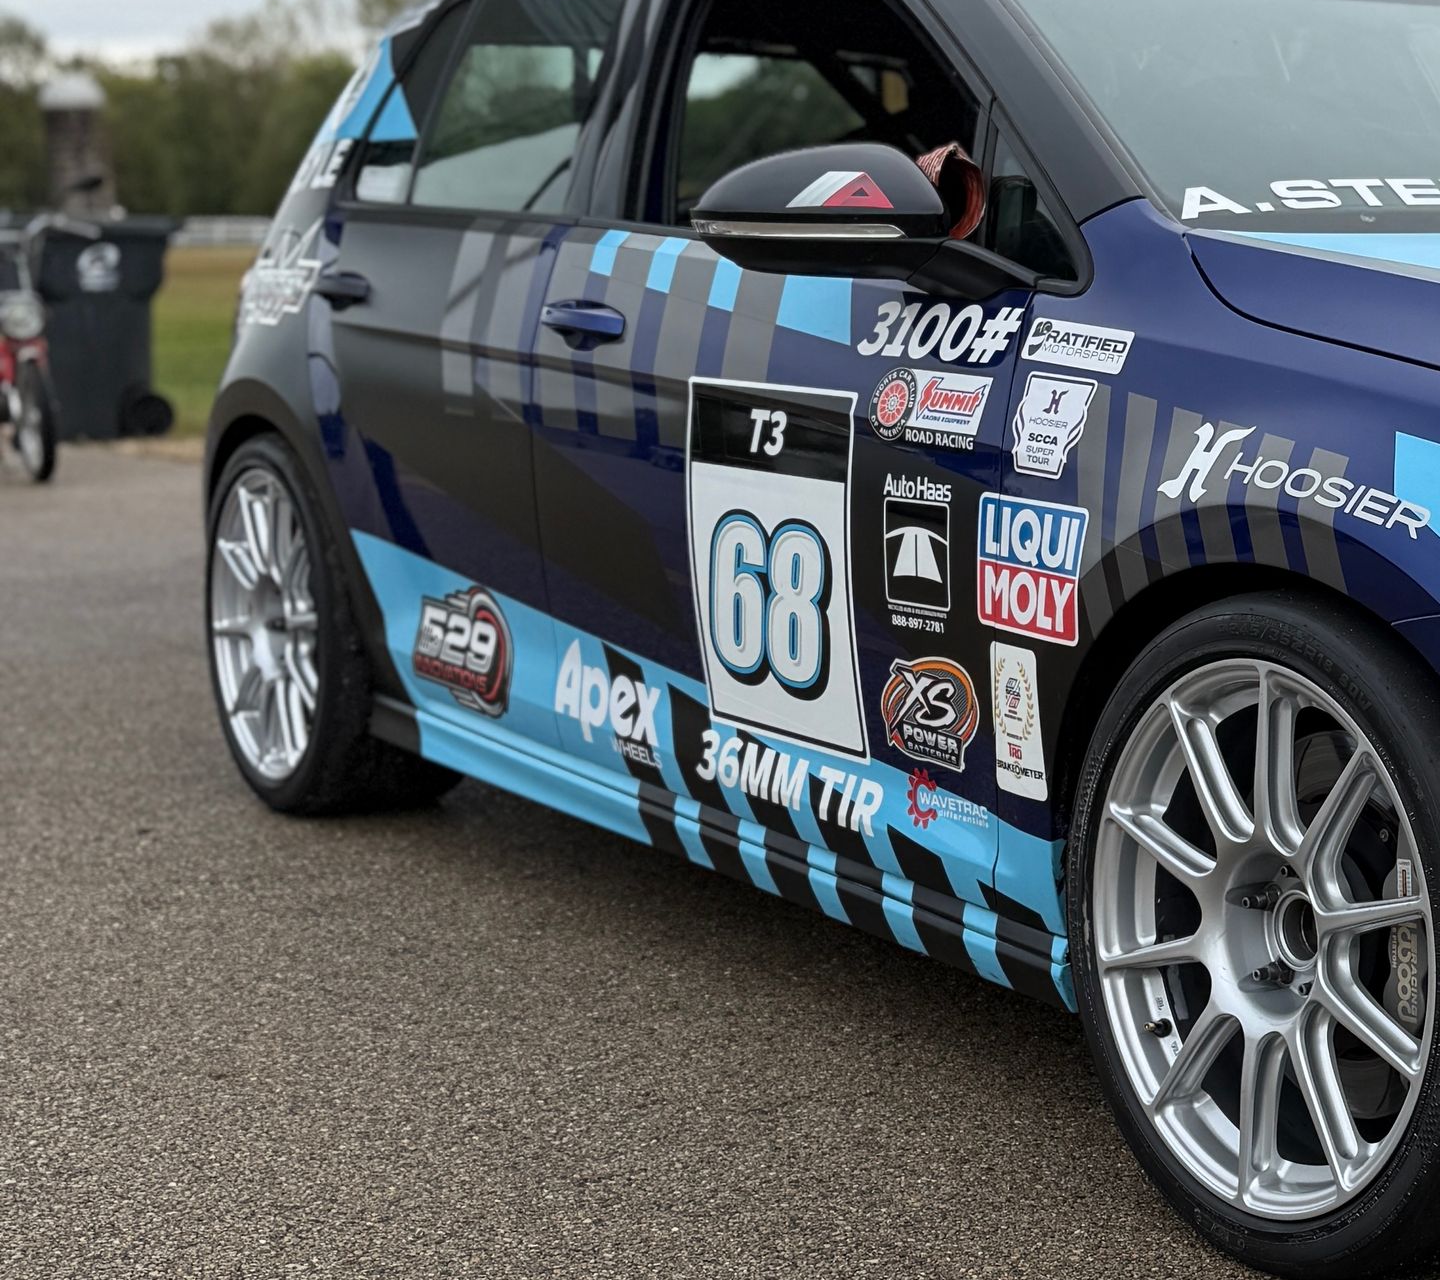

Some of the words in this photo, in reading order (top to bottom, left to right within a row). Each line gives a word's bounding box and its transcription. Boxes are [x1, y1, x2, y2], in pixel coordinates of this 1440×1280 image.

[857, 301, 1025, 364] 3100#
[1042, 343, 1123, 364] MOTORSPORT
[749, 409, 788, 457] T3
[905, 428, 933, 444] ROAD
[935, 434, 974, 450] RACING
[1028, 433, 1058, 446] SCCA
[1029, 417, 1068, 429] HOOSIER
[1026, 445, 1054, 456] SUPER
[1026, 455, 1050, 466] TOUR
[1223, 451, 1431, 540] HOOSIER
[985, 504, 1081, 571] LIQUI
[709, 510, 828, 692] 68
[984, 565, 1075, 633] MOLY
[418, 605, 497, 674] 529
[555, 639, 661, 747] Apex
[891, 671, 957, 727] XS
[609, 736, 664, 769] WHEELS
[903, 723, 959, 755] POWER
[907, 741, 957, 764] BATTERIES
[696, 729, 809, 811] 36MM
[819, 765, 884, 837] TIR
[919, 791, 989, 818] WAVETRAC
[938, 811, 989, 829] differentials
